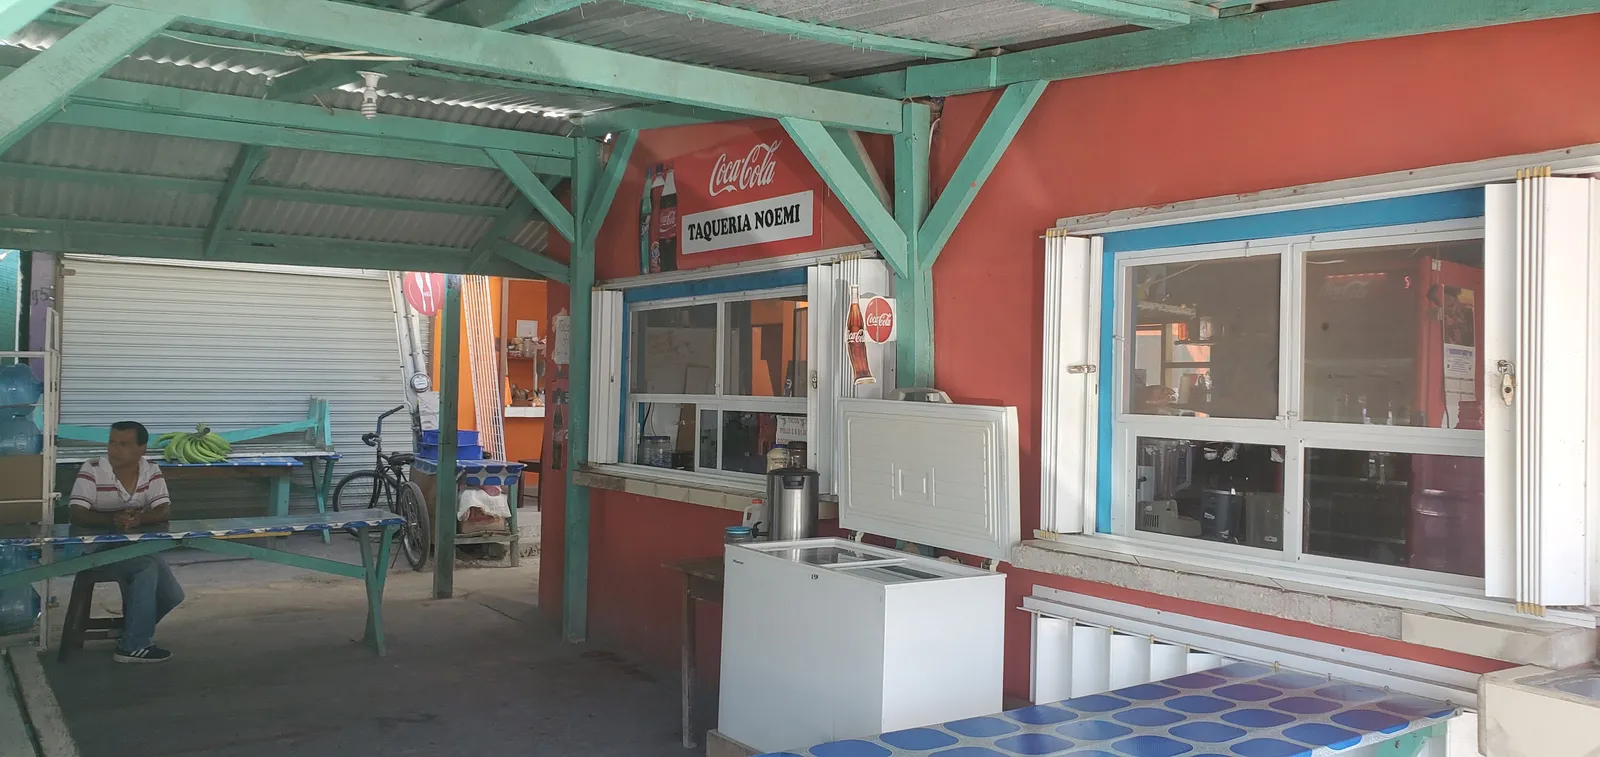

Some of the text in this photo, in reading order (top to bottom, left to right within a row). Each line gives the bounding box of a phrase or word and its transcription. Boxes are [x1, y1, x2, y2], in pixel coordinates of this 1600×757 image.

[709, 139, 783, 196] Coca-Cola
[688, 203, 800, 241] TAQUERIA NOEMI
